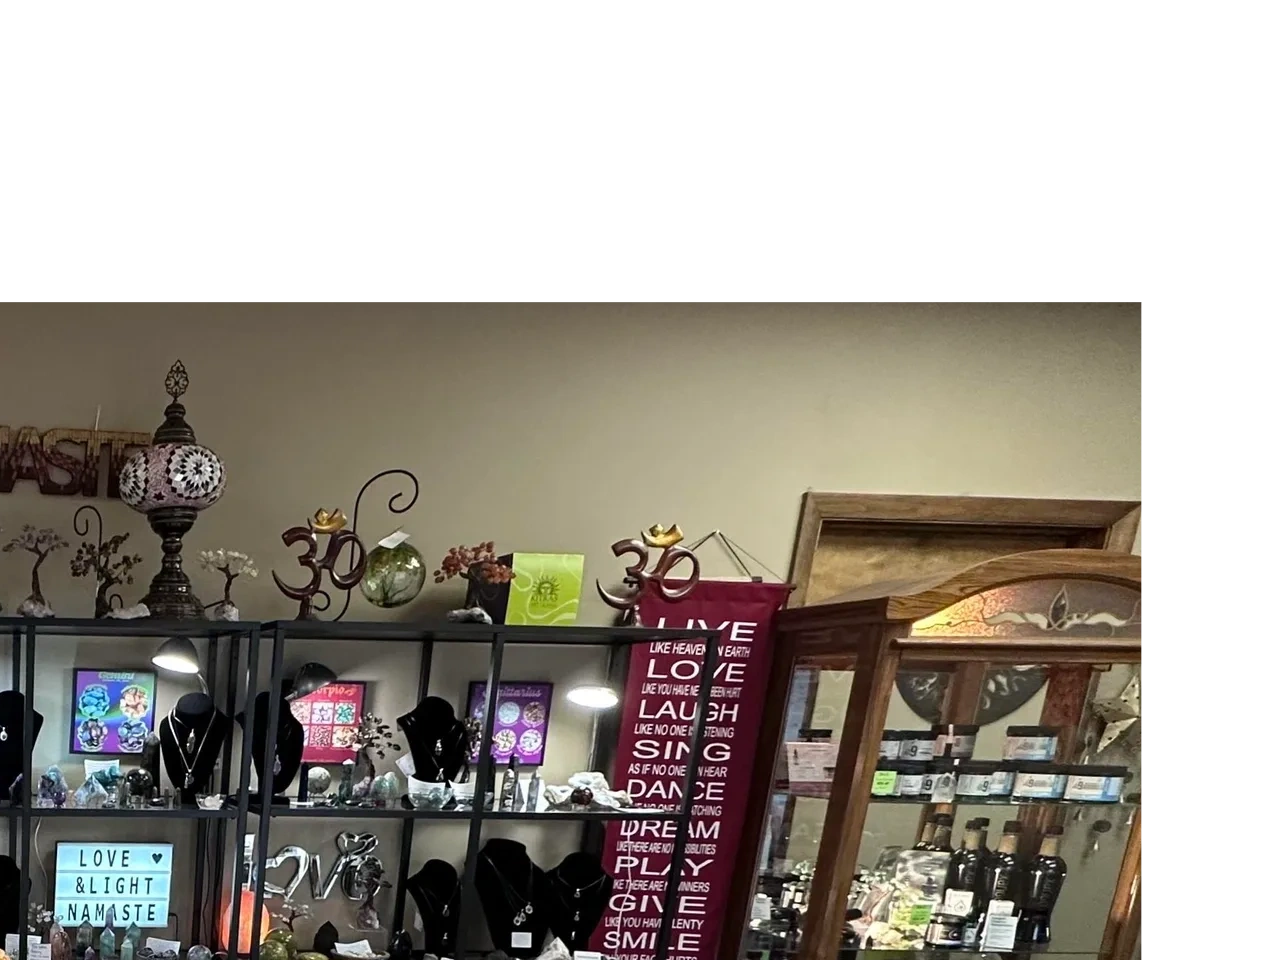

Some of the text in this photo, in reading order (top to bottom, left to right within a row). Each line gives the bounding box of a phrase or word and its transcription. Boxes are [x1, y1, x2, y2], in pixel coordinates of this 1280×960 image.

[649, 642, 671, 654] LIKE
[724, 646, 751, 658] EARTH
[638, 699, 739, 722] LAUGH
[634, 723, 655, 735] LIKE
[655, 724, 669, 735] NO
[669, 724, 687, 736] ONE
[632, 739, 731, 762] SING
[628, 763, 640, 774] AS
[641, 763, 651, 775] IF
[652, 764, 667, 775] NO
[668, 765, 686, 776] ONE
[703, 766, 728, 778] HEAR
[627, 779, 726, 801] DANCE
[79, 849, 130, 867] LOVE
[613, 879, 624, 890] IKE
[67, 903, 156, 921] NAMASTE
[622, 917, 641, 928] YOU
[671, 918, 704, 930] LENTY
